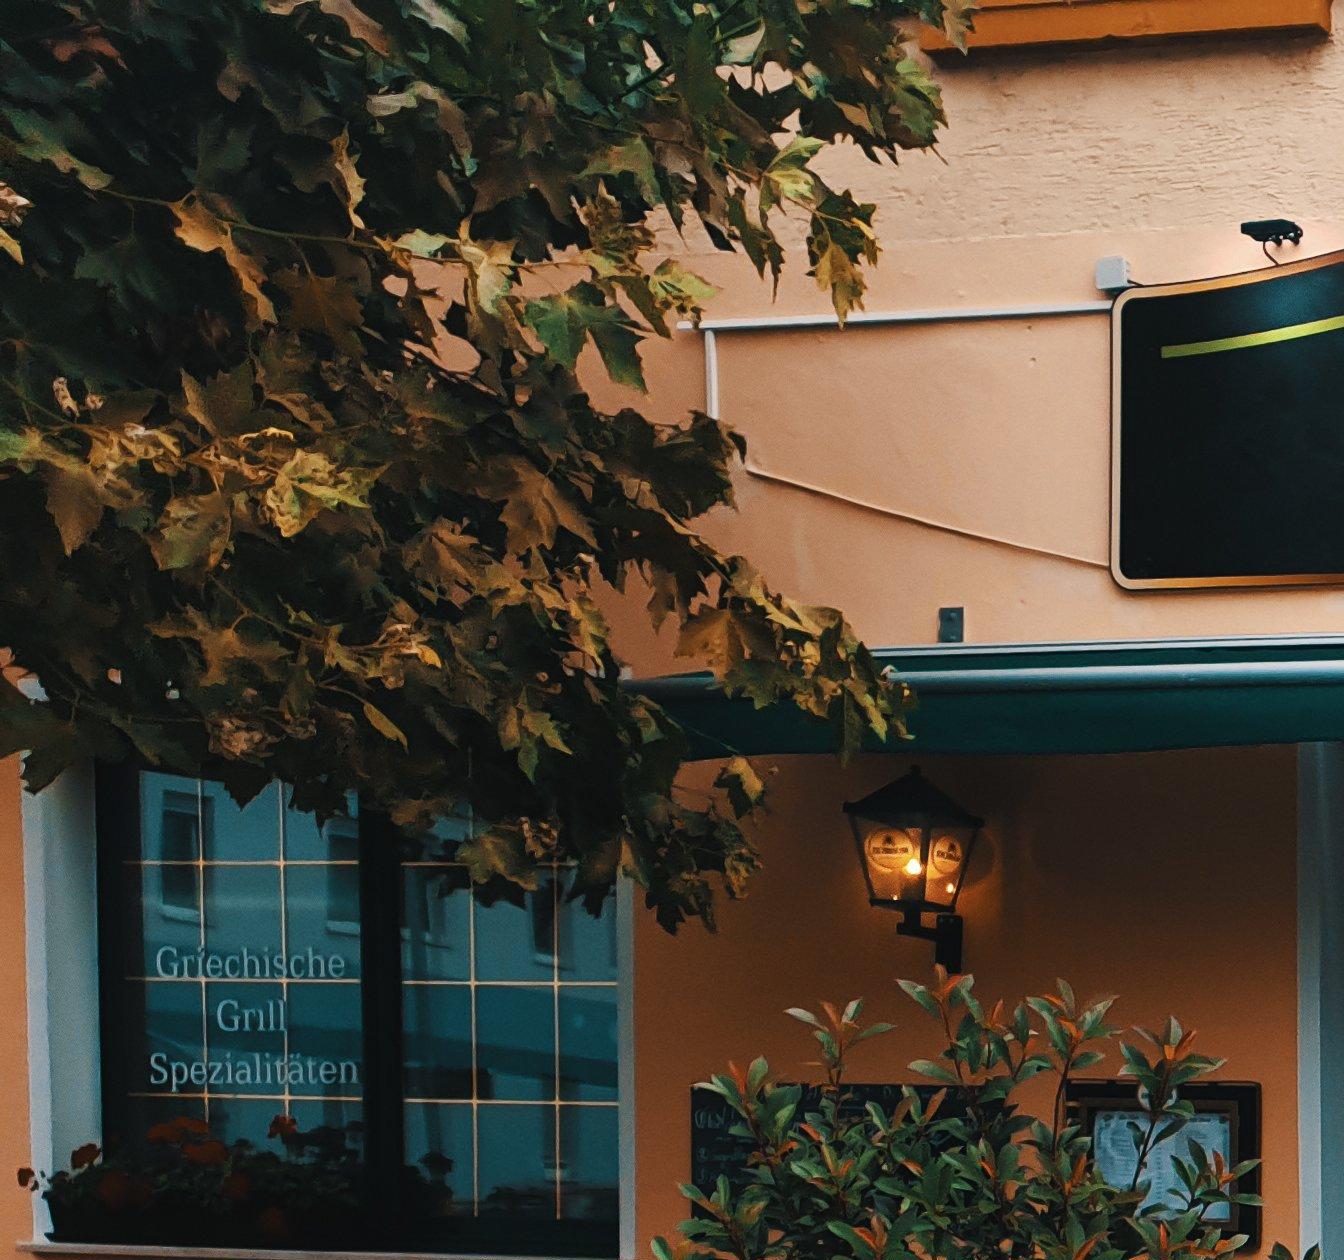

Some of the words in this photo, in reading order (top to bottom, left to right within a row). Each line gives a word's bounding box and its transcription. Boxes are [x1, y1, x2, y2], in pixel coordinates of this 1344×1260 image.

[156, 946, 345, 980] Griechische
[216, 999, 288, 1033] Grill
[149, 1052, 359, 1092] Spezialitäten
